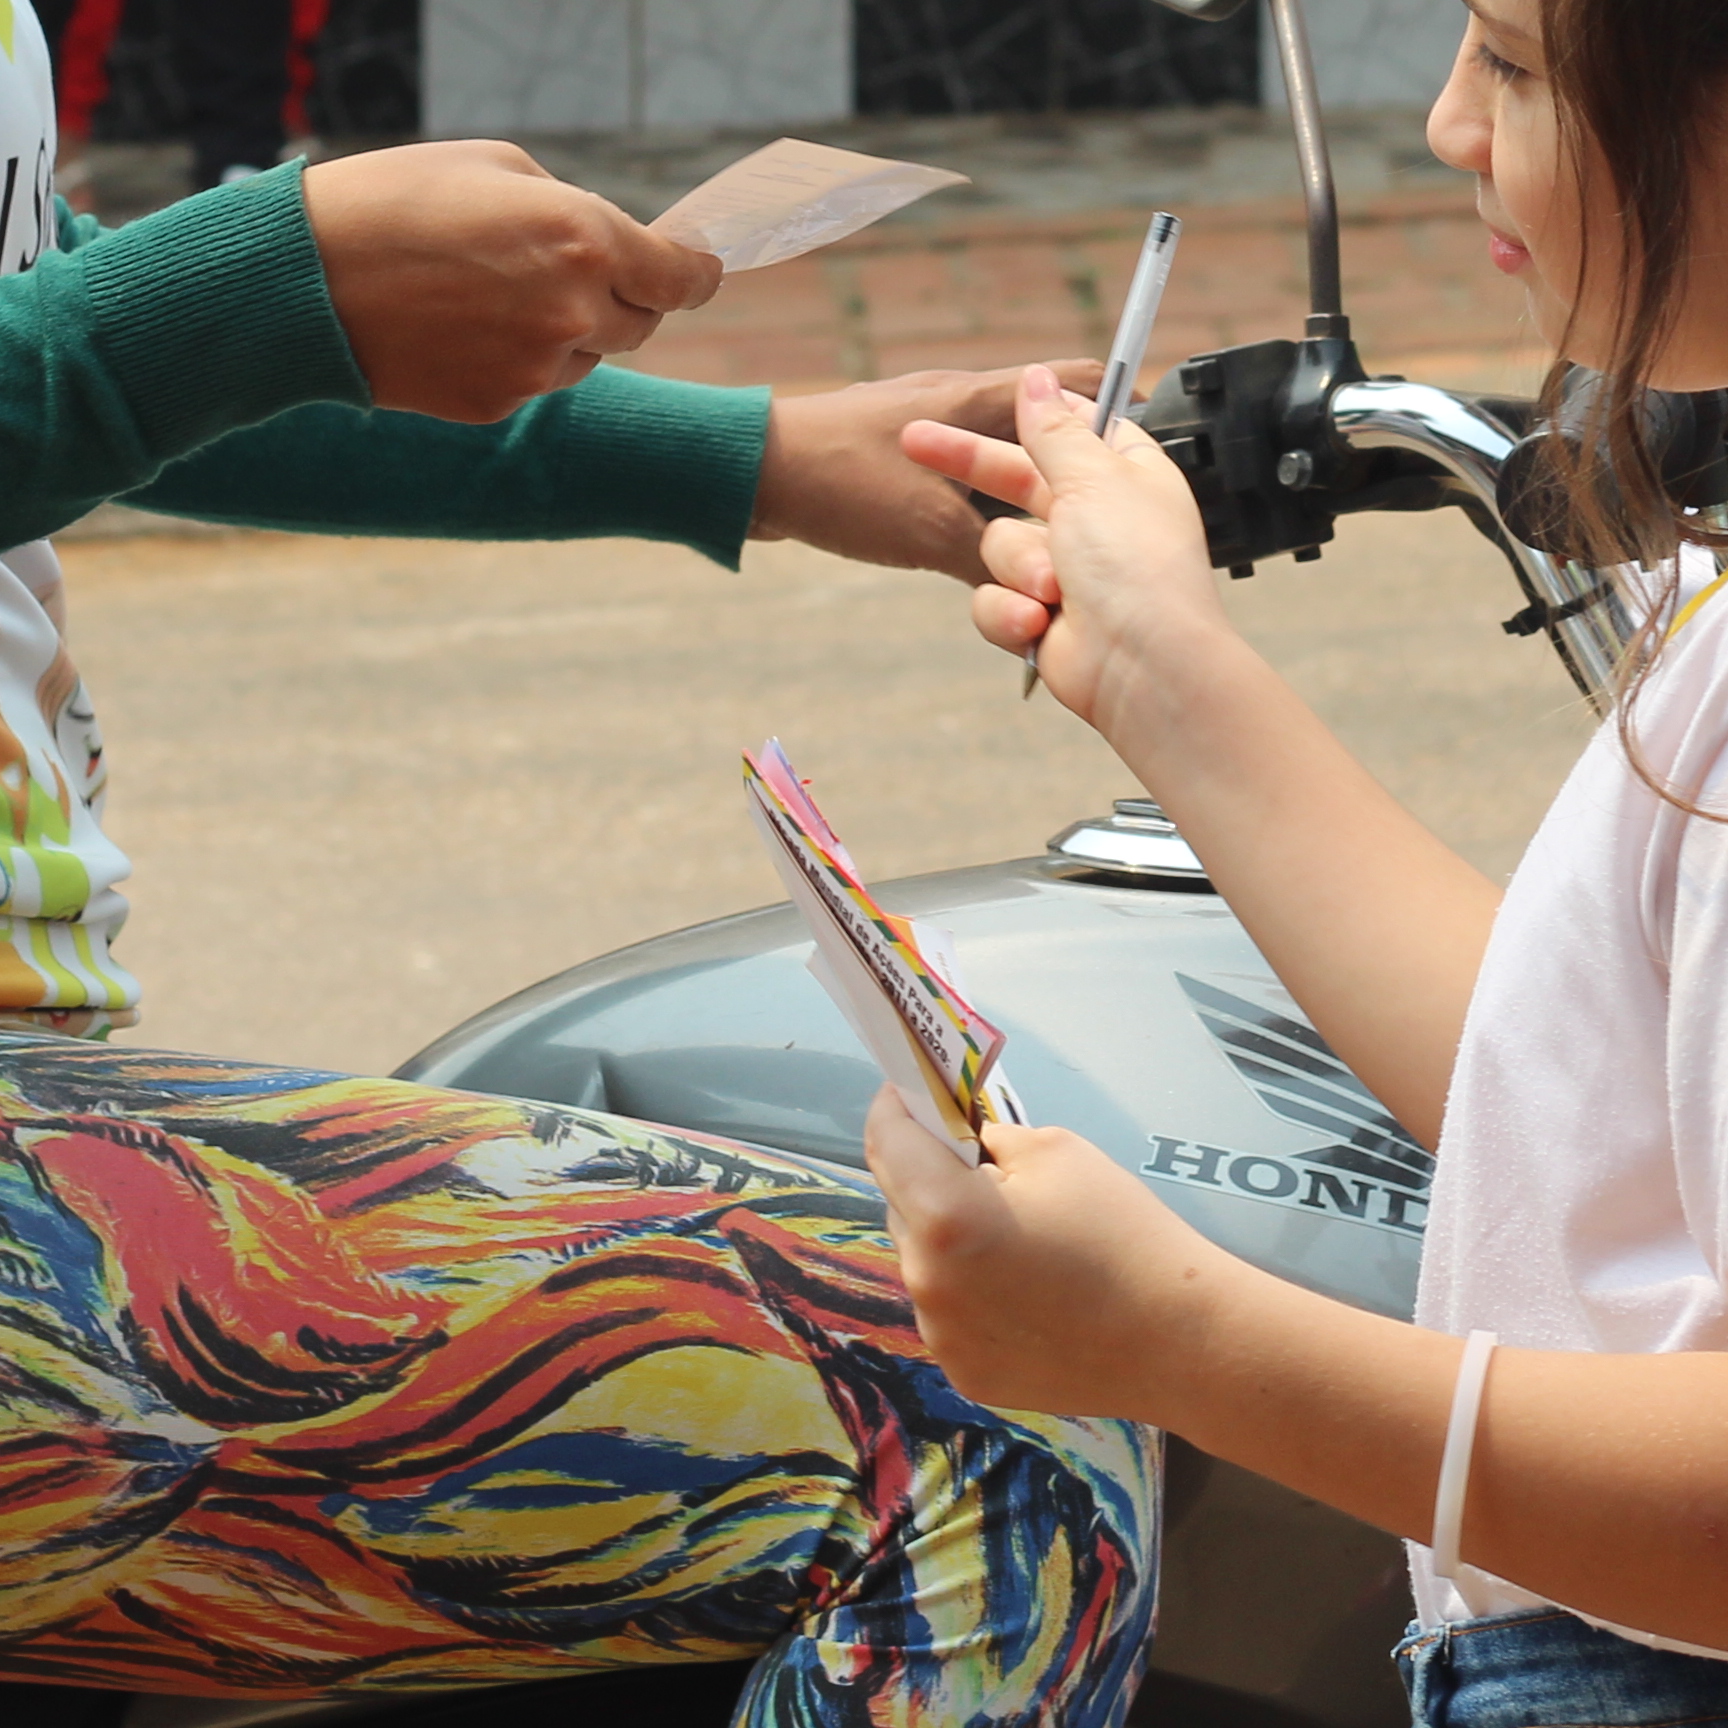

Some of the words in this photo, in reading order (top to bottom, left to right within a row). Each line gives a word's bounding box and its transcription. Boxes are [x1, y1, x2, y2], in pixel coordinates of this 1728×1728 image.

[855, 923, 871, 946] de
[908, 985, 934, 1025] Para
[935, 1023, 944, 1039] a
[1143, 1135, 1430, 1233] HOND
